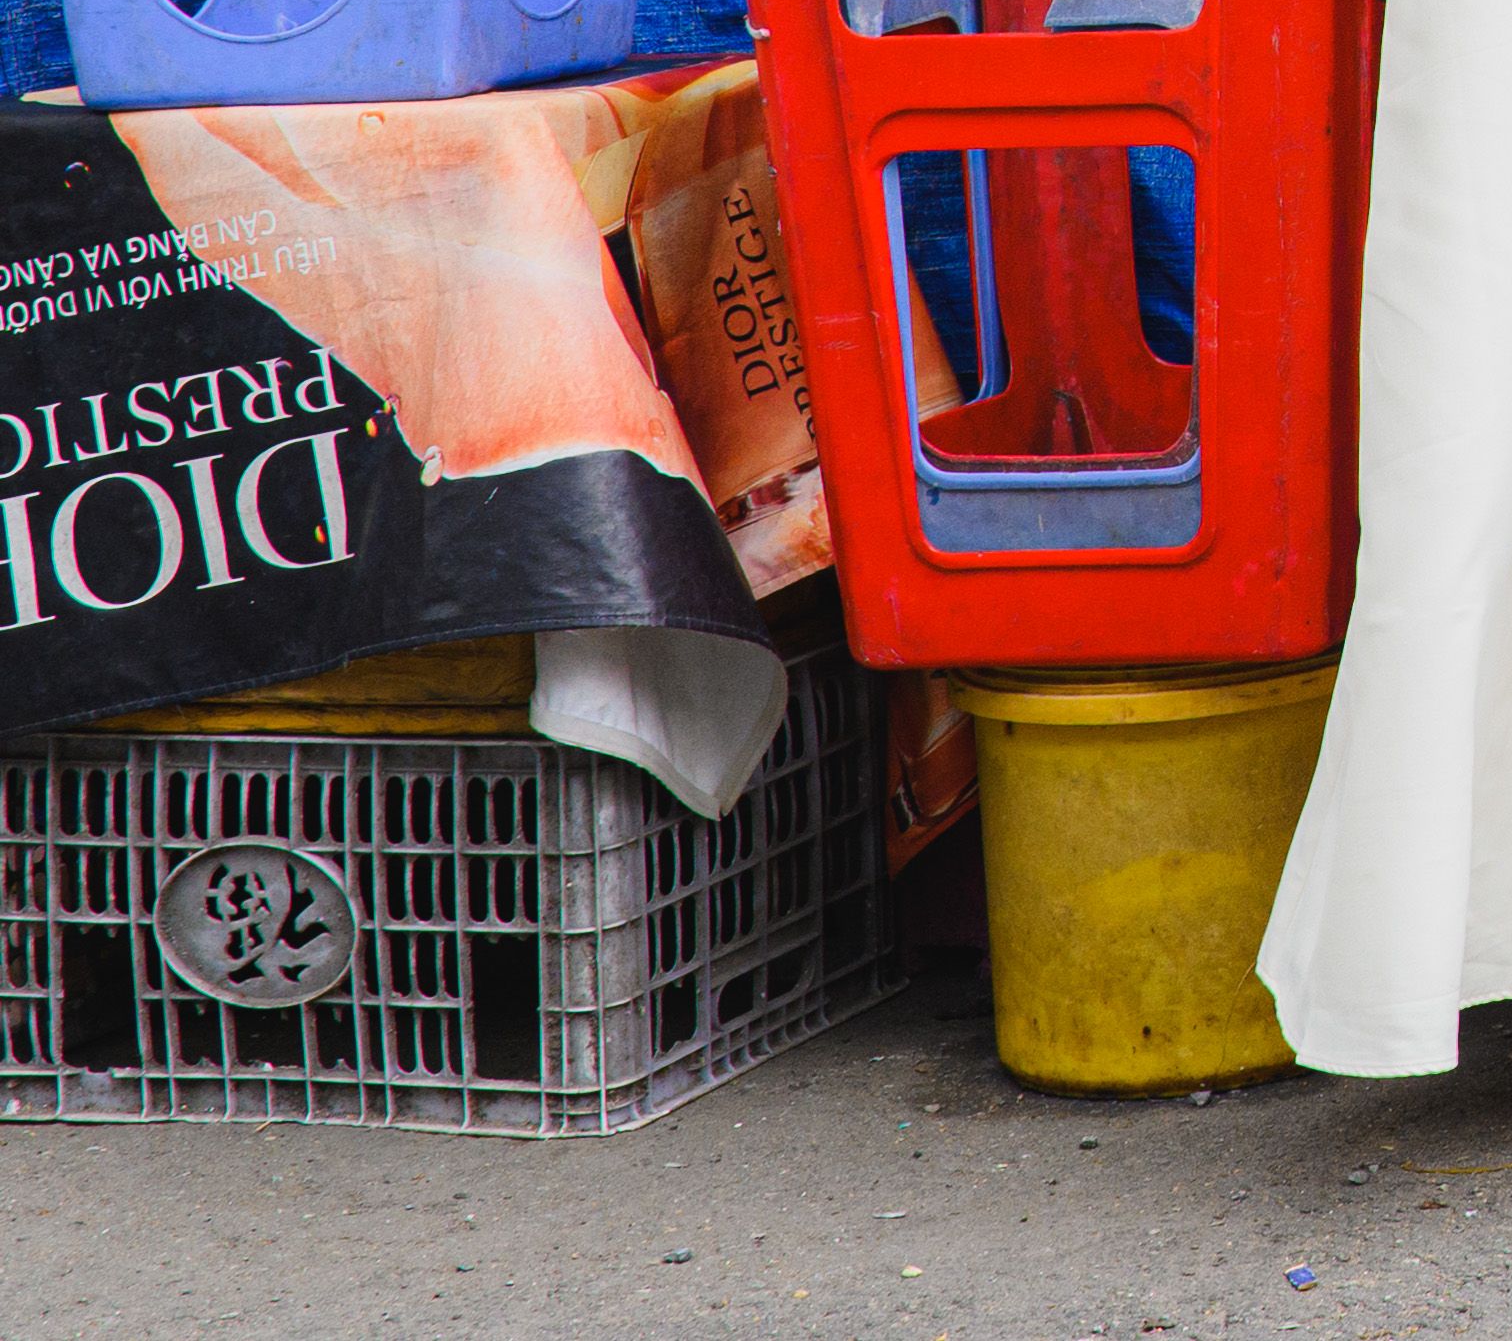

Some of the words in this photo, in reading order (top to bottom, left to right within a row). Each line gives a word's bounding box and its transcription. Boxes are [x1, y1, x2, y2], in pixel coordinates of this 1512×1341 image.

[125, 221, 211, 264] BẰNG
[215, 208, 278, 247] CÂN
[79, 242, 122, 279] VÀ
[176, 249, 267, 293] TRÌNH
[273, 235, 338, 276] LIỆU
[83, 282, 115, 314] VI
[117, 270, 174, 311] VỚI
[712, 263, 782, 402] DIOR
